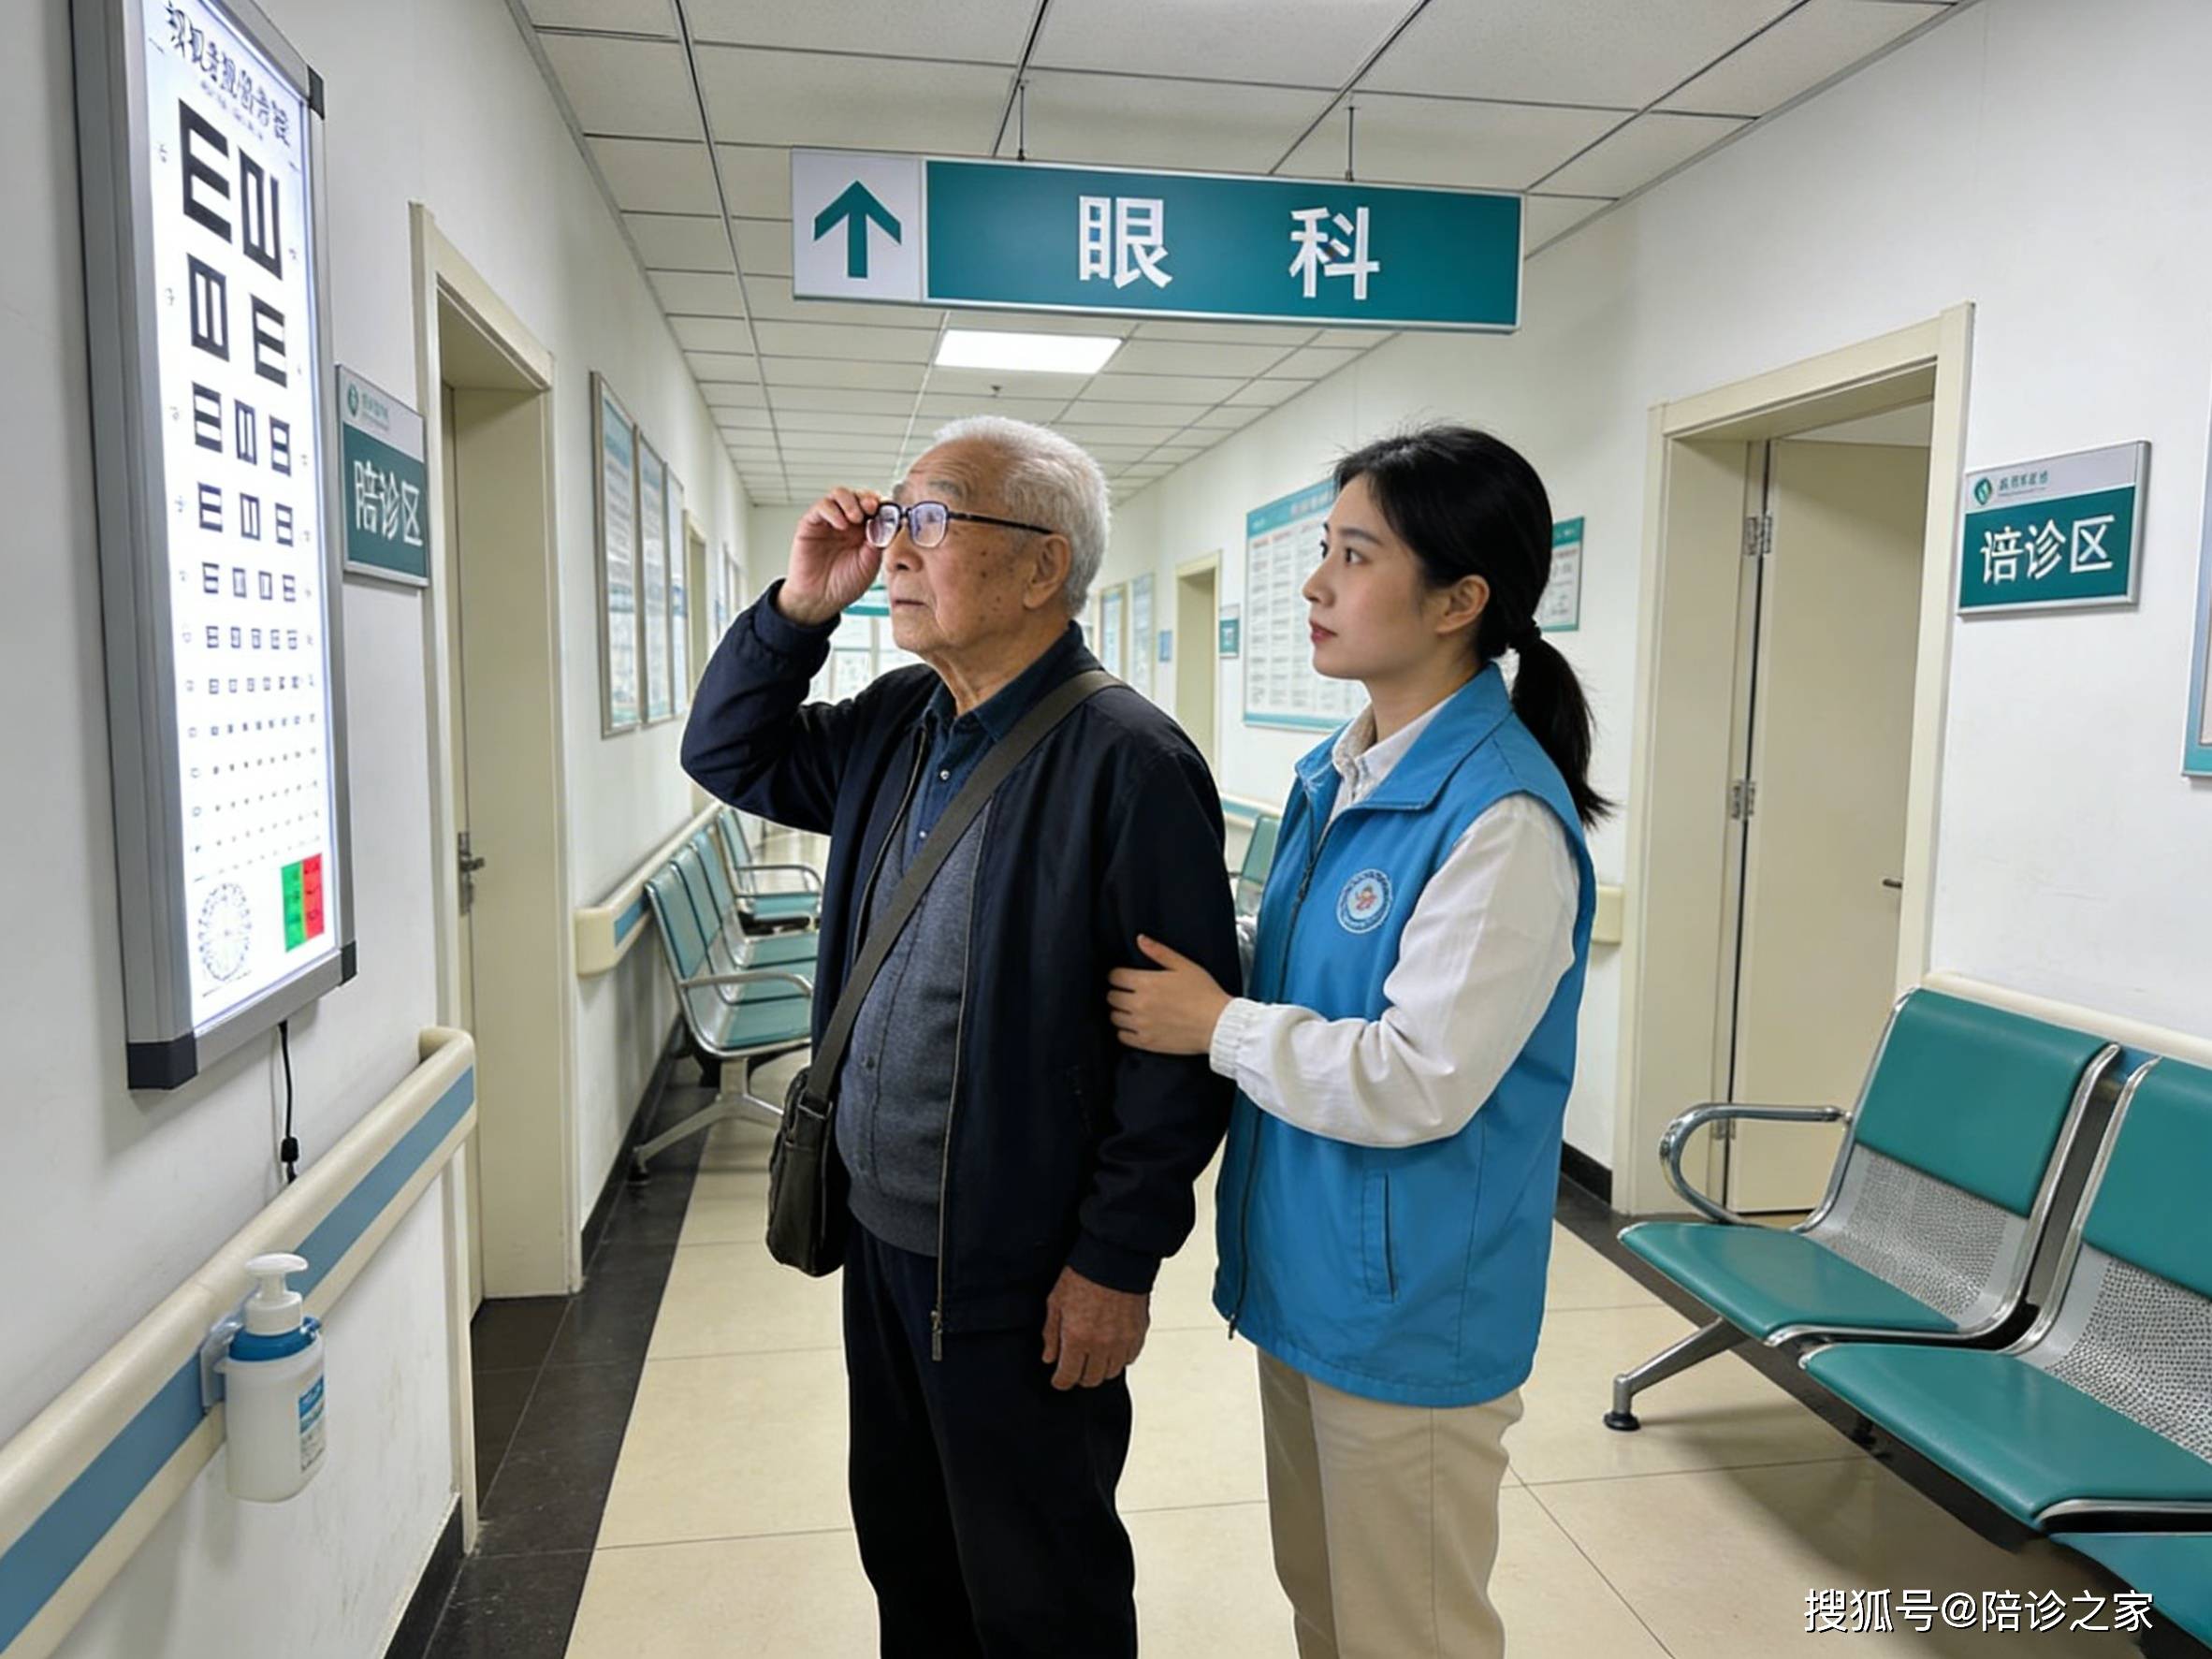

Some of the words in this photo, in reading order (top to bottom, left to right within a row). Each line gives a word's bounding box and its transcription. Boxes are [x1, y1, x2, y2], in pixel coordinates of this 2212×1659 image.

[1077, 195, 1379, 300] 眼科
[353, 459, 424, 546] 陪诊区
